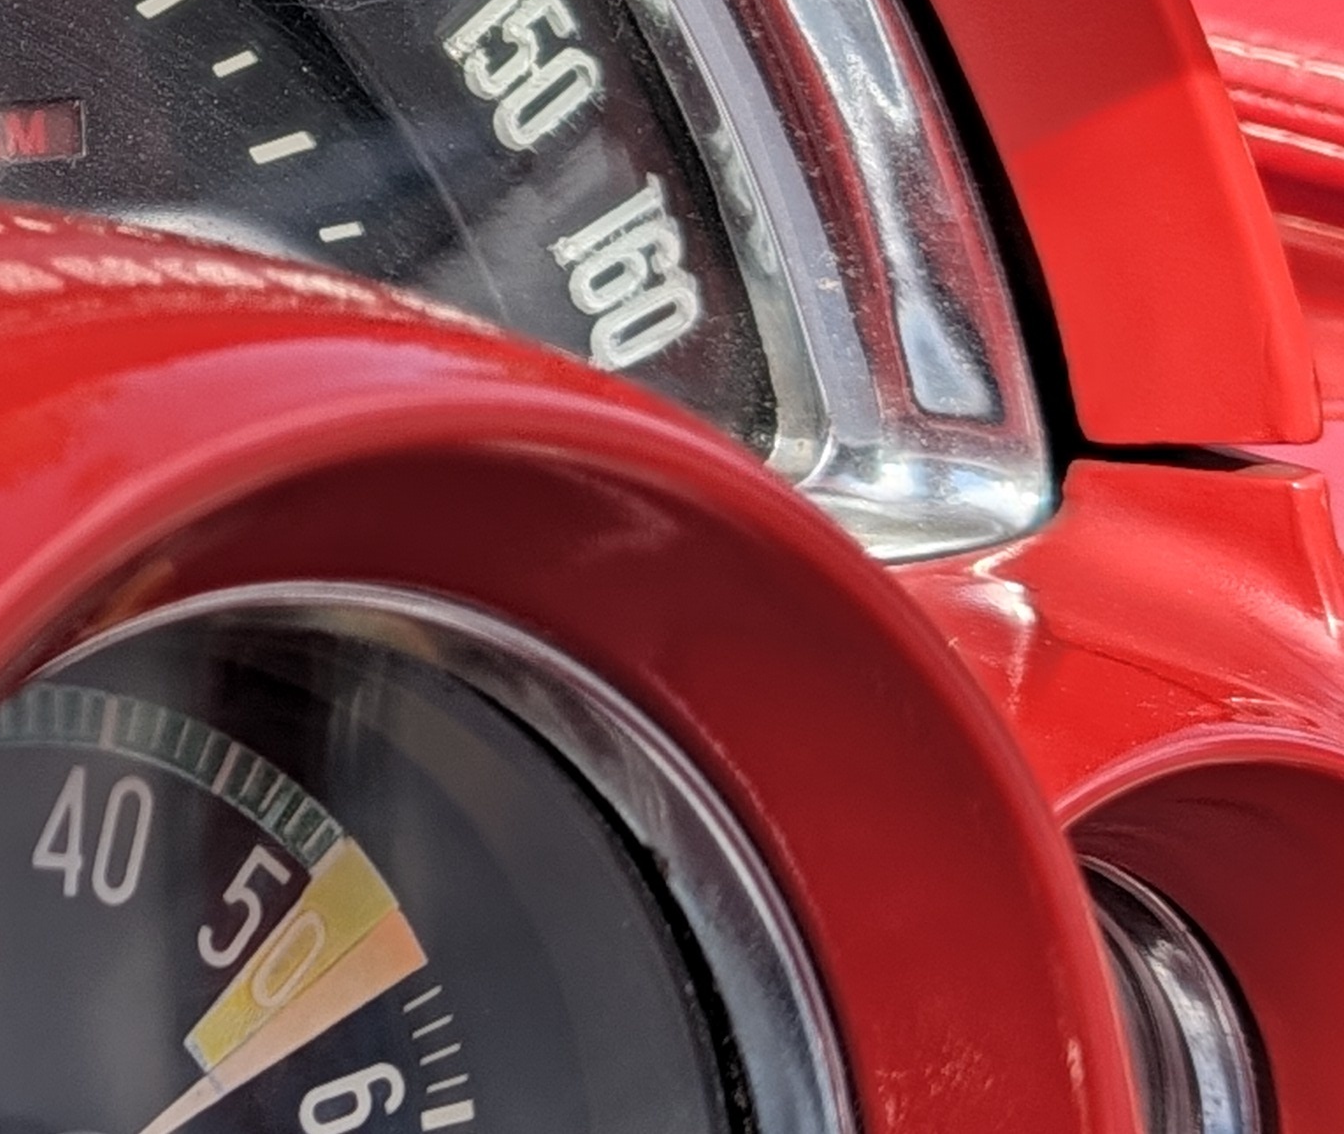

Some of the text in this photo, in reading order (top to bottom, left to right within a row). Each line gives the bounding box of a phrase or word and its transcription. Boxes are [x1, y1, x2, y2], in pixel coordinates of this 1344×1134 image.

[551, 175, 701, 370] 160
[32, 765, 154, 905] 40
[197, 845, 326, 1008] 50
